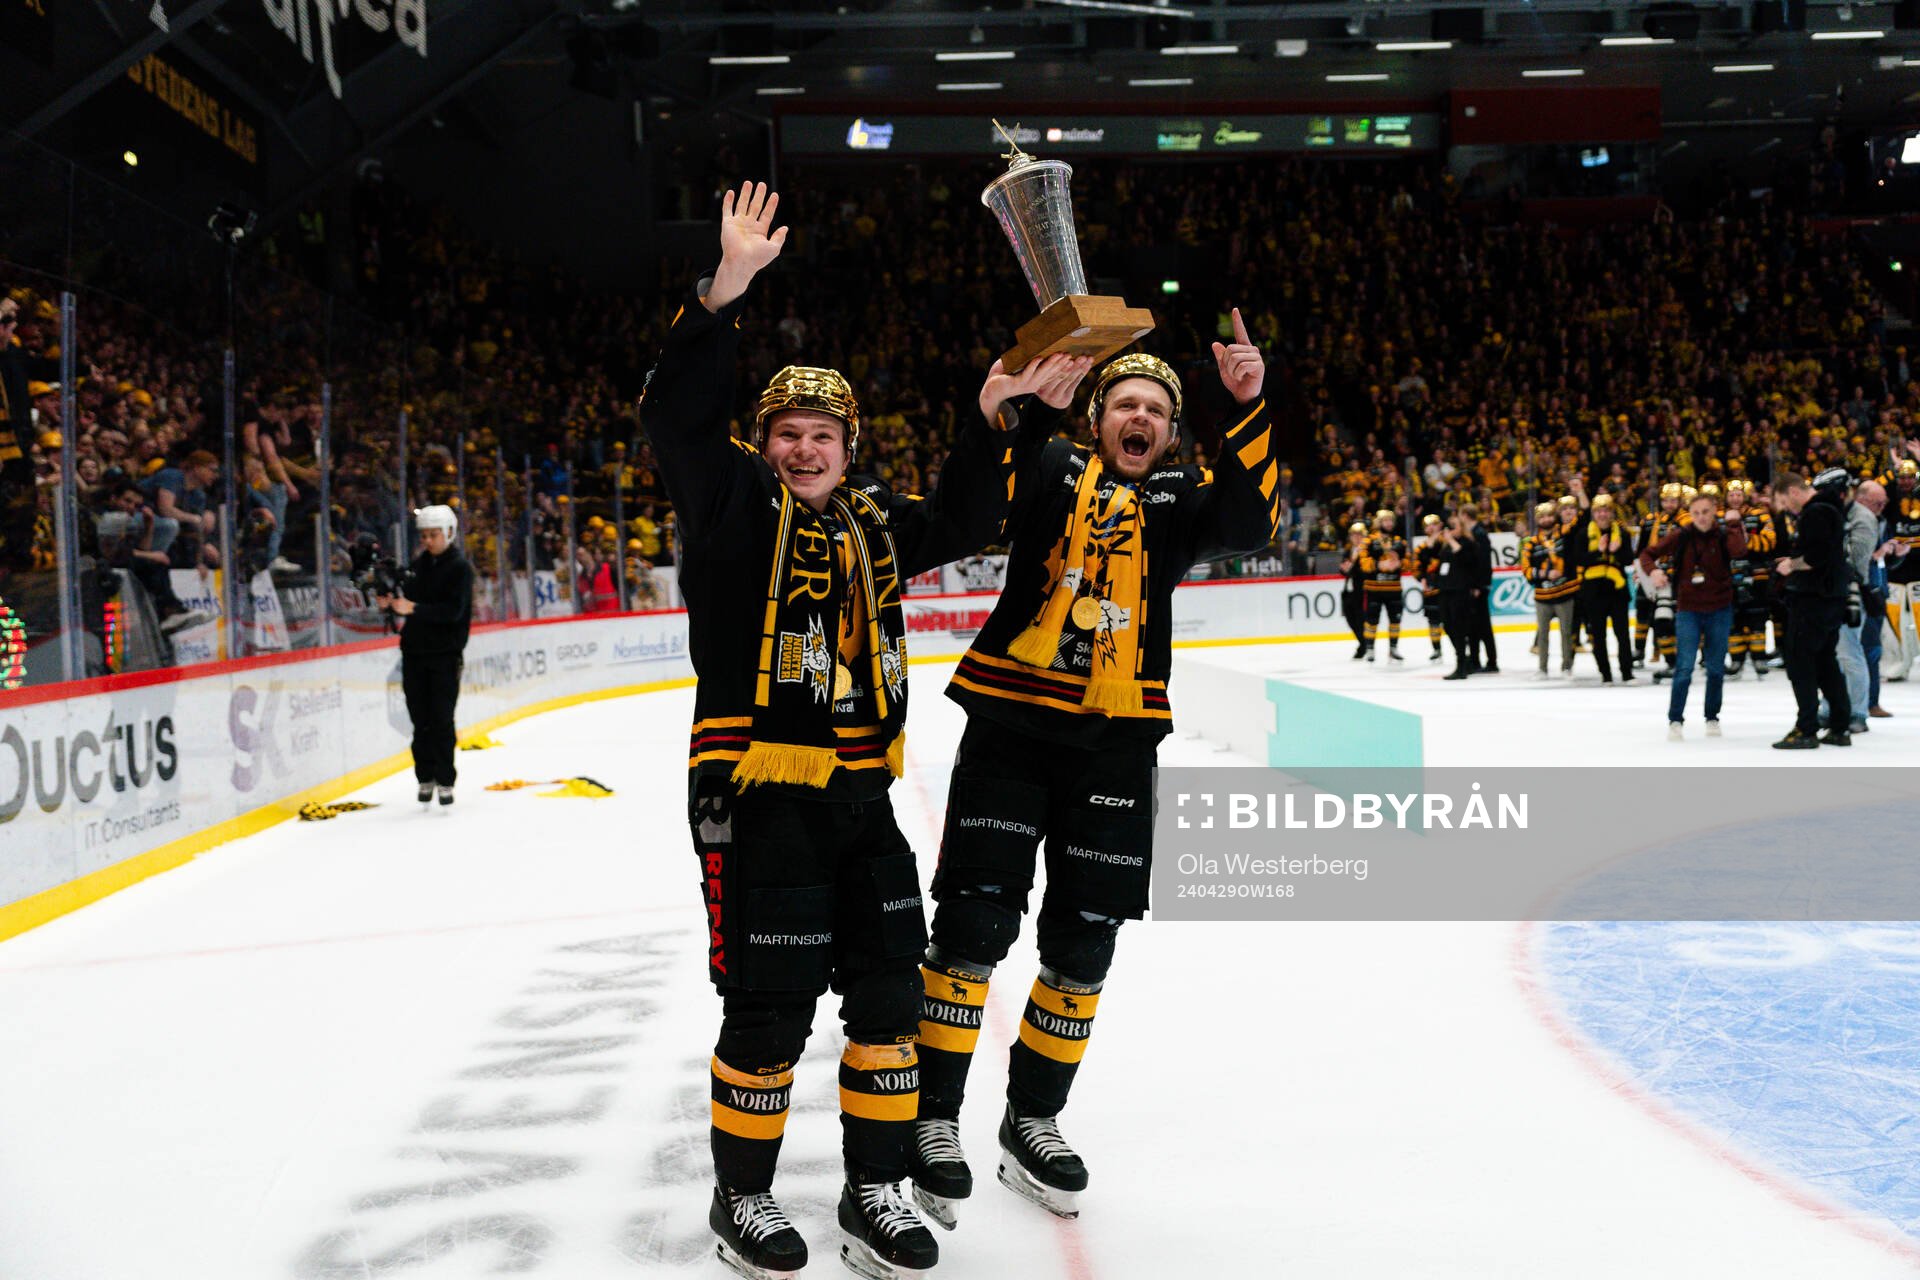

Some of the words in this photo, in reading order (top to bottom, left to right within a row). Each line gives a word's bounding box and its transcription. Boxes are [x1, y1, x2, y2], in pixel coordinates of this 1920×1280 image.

[780, 635, 793, 680] POWER
[791, 636, 804, 680] NORTH
[1090, 795, 1136, 808] CCM
[101, 801, 181, 843] Consultants
[960, 816, 1038, 837] MARTINSONS
[1066, 845, 1144, 867] MARTINSONS
[705, 852, 727, 975] REPAY
[750, 933, 832, 945] MARTINSONS
